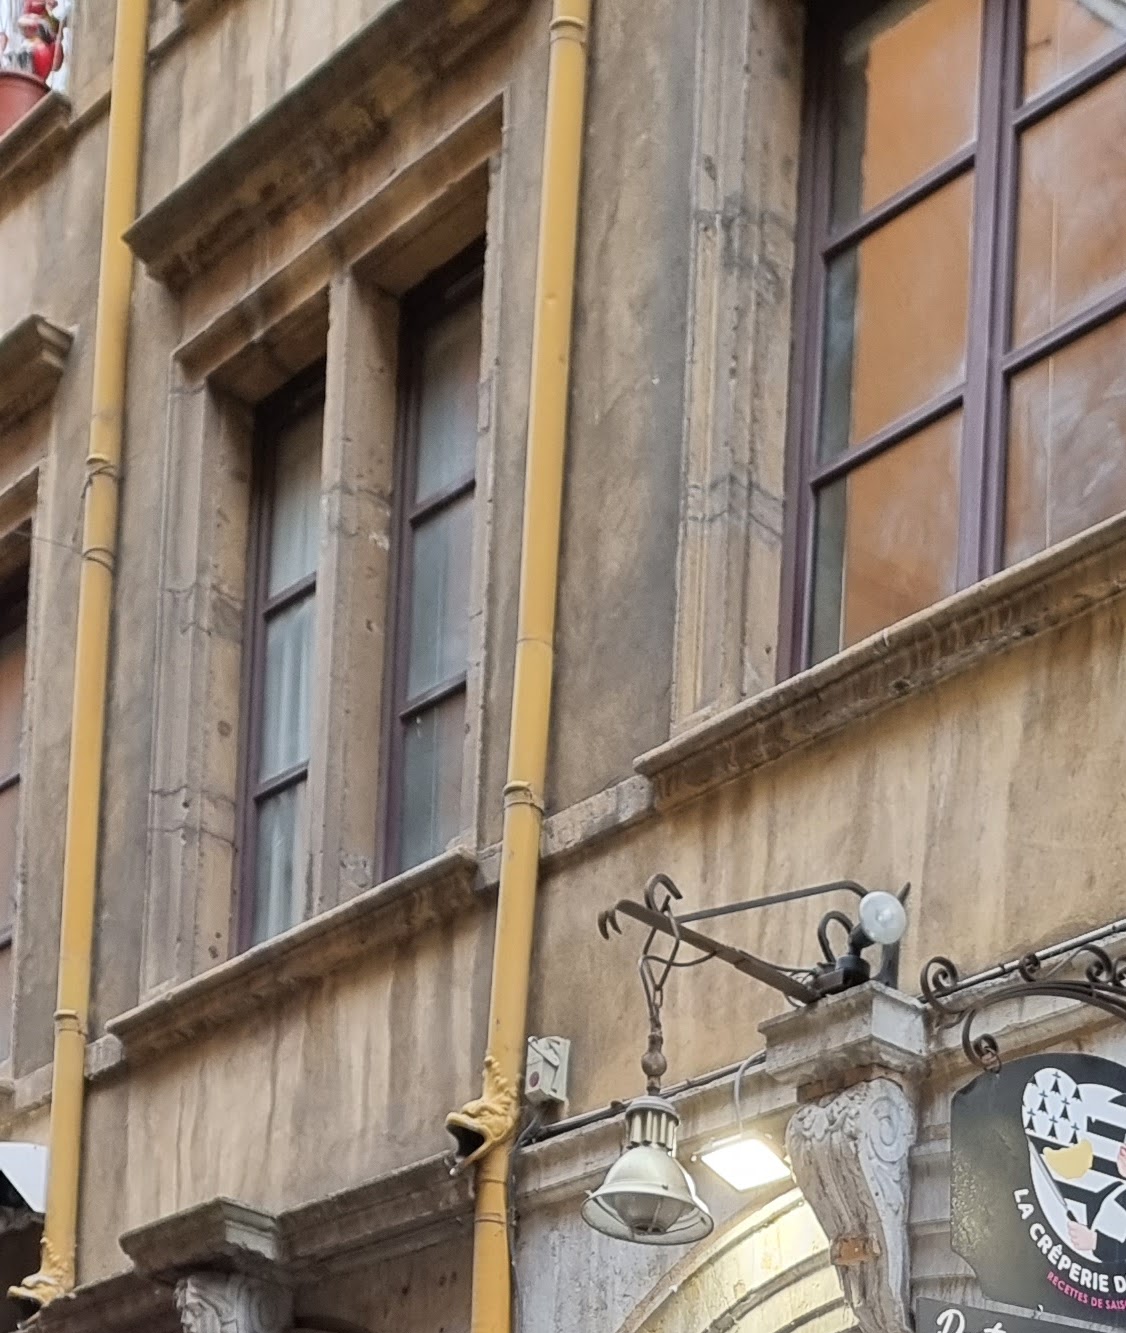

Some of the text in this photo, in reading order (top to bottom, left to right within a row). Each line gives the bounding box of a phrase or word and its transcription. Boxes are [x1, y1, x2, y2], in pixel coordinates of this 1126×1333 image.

[1014, 1188, 1034, 1220] LA
[1029, 1223, 1109, 1293] CRÊPERIE
[1047, 1271, 1088, 1305] RECETTES
[1090, 1297, 1103, 1309] DE
